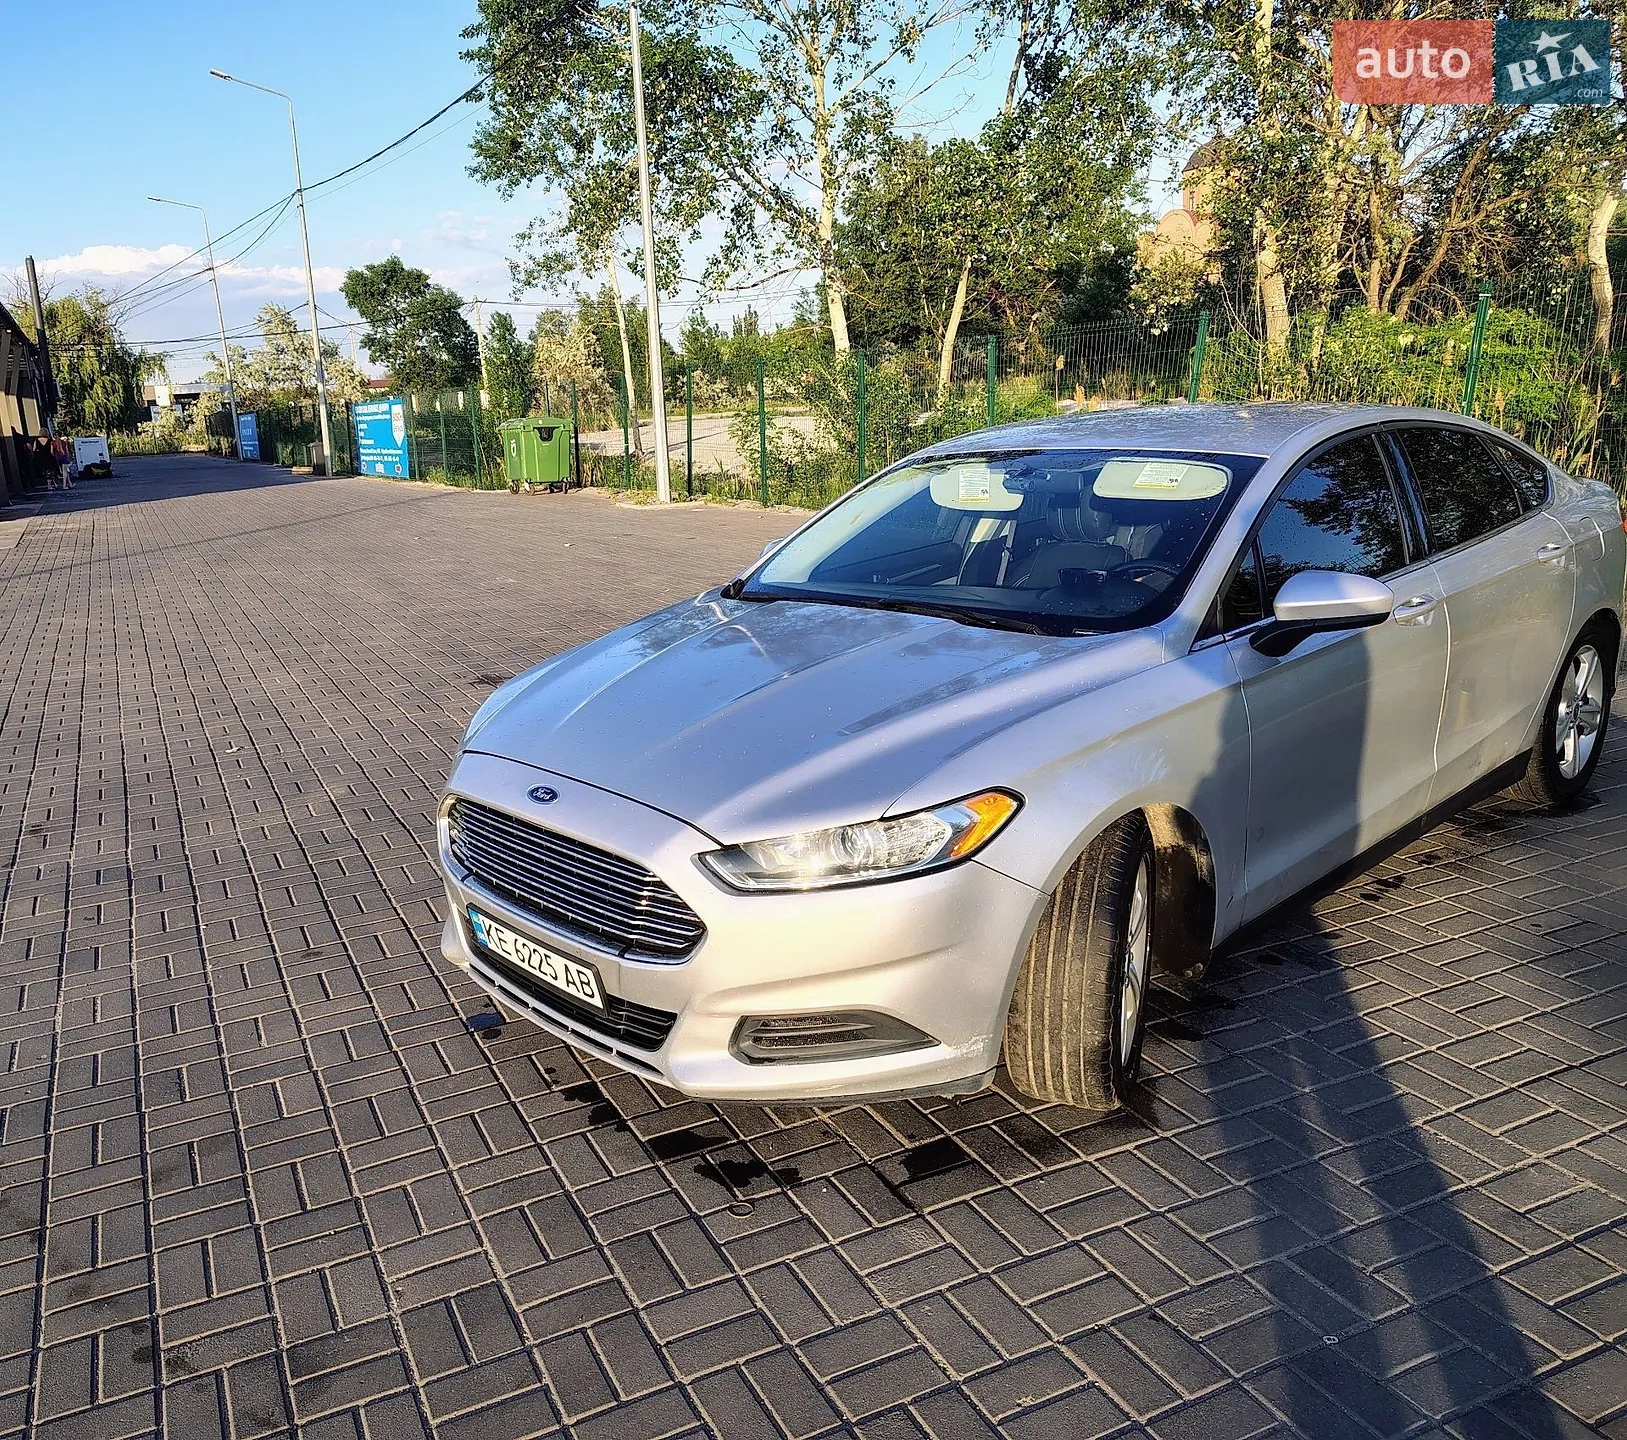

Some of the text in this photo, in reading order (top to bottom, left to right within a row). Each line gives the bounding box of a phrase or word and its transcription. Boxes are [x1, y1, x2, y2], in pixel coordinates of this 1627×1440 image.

[532, 788, 553, 800] Ford
[482, 919, 595, 999] KE 6225 AB
